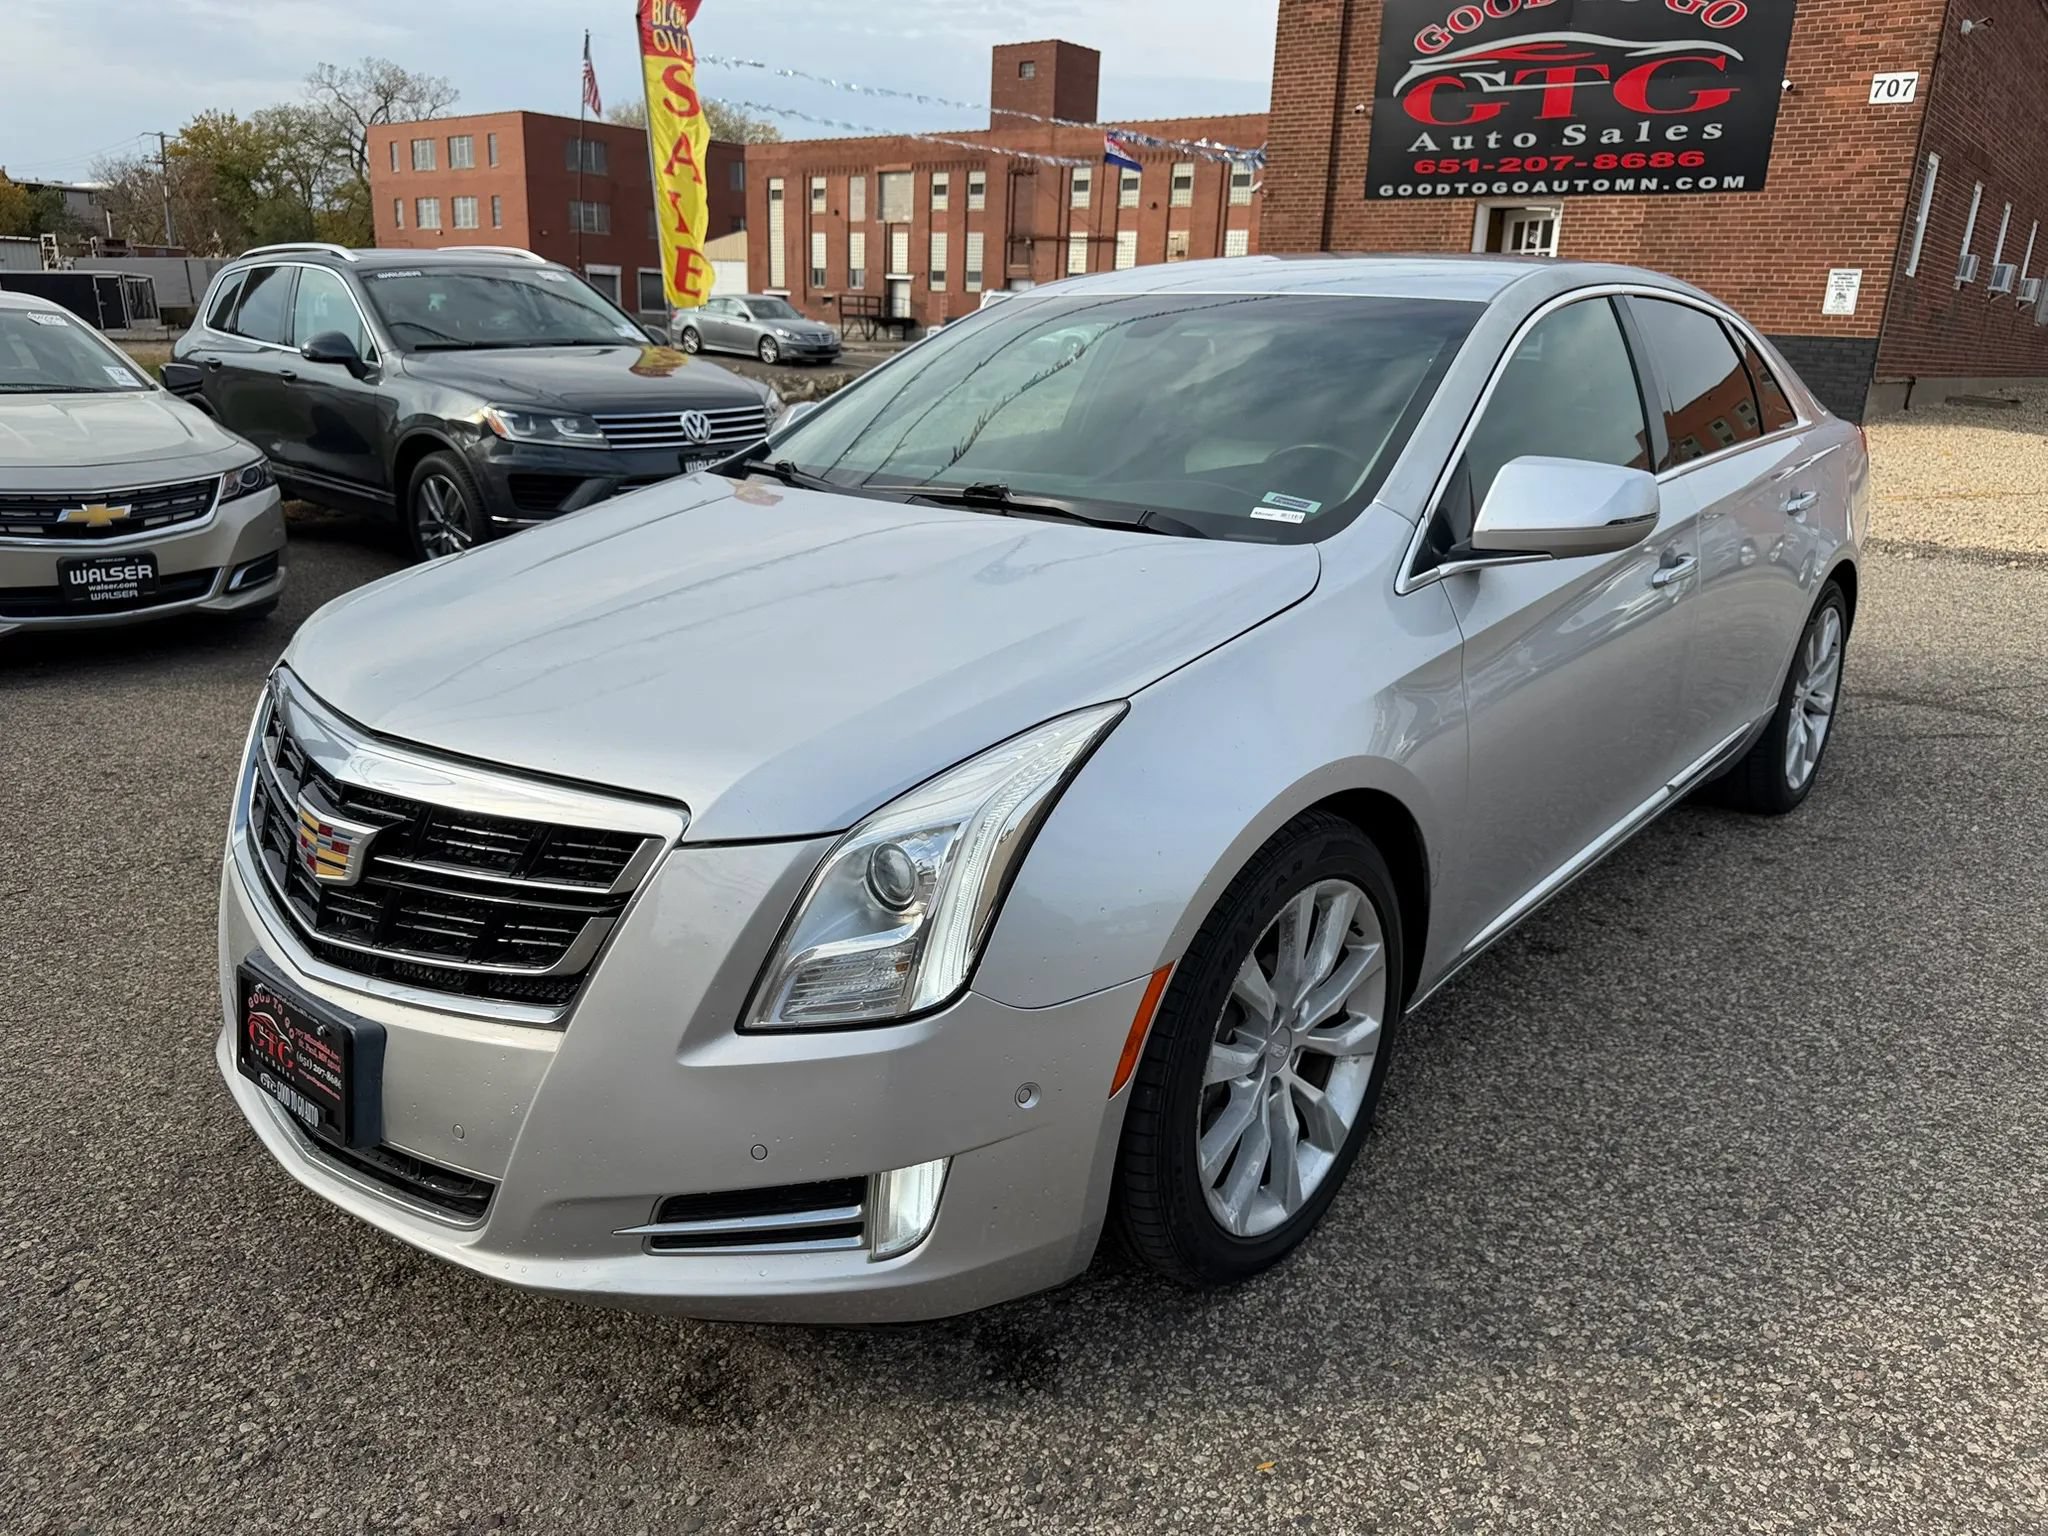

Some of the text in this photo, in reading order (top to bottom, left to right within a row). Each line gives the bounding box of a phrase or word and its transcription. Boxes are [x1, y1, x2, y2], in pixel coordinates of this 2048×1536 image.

[1402, 55, 1741, 126] GTG
[1873, 78, 1916, 98] 707
[1407, 120, 1724, 153] Auto Sales
[1413, 150, 1705, 175] 651-207-8686
[1378, 175, 1745, 197] GOODTOGOAUTOMN.COM
[69, 564, 153, 585] WALSER
[88, 582, 138, 592] walser.com
[90, 589, 139, 601] WALSER
